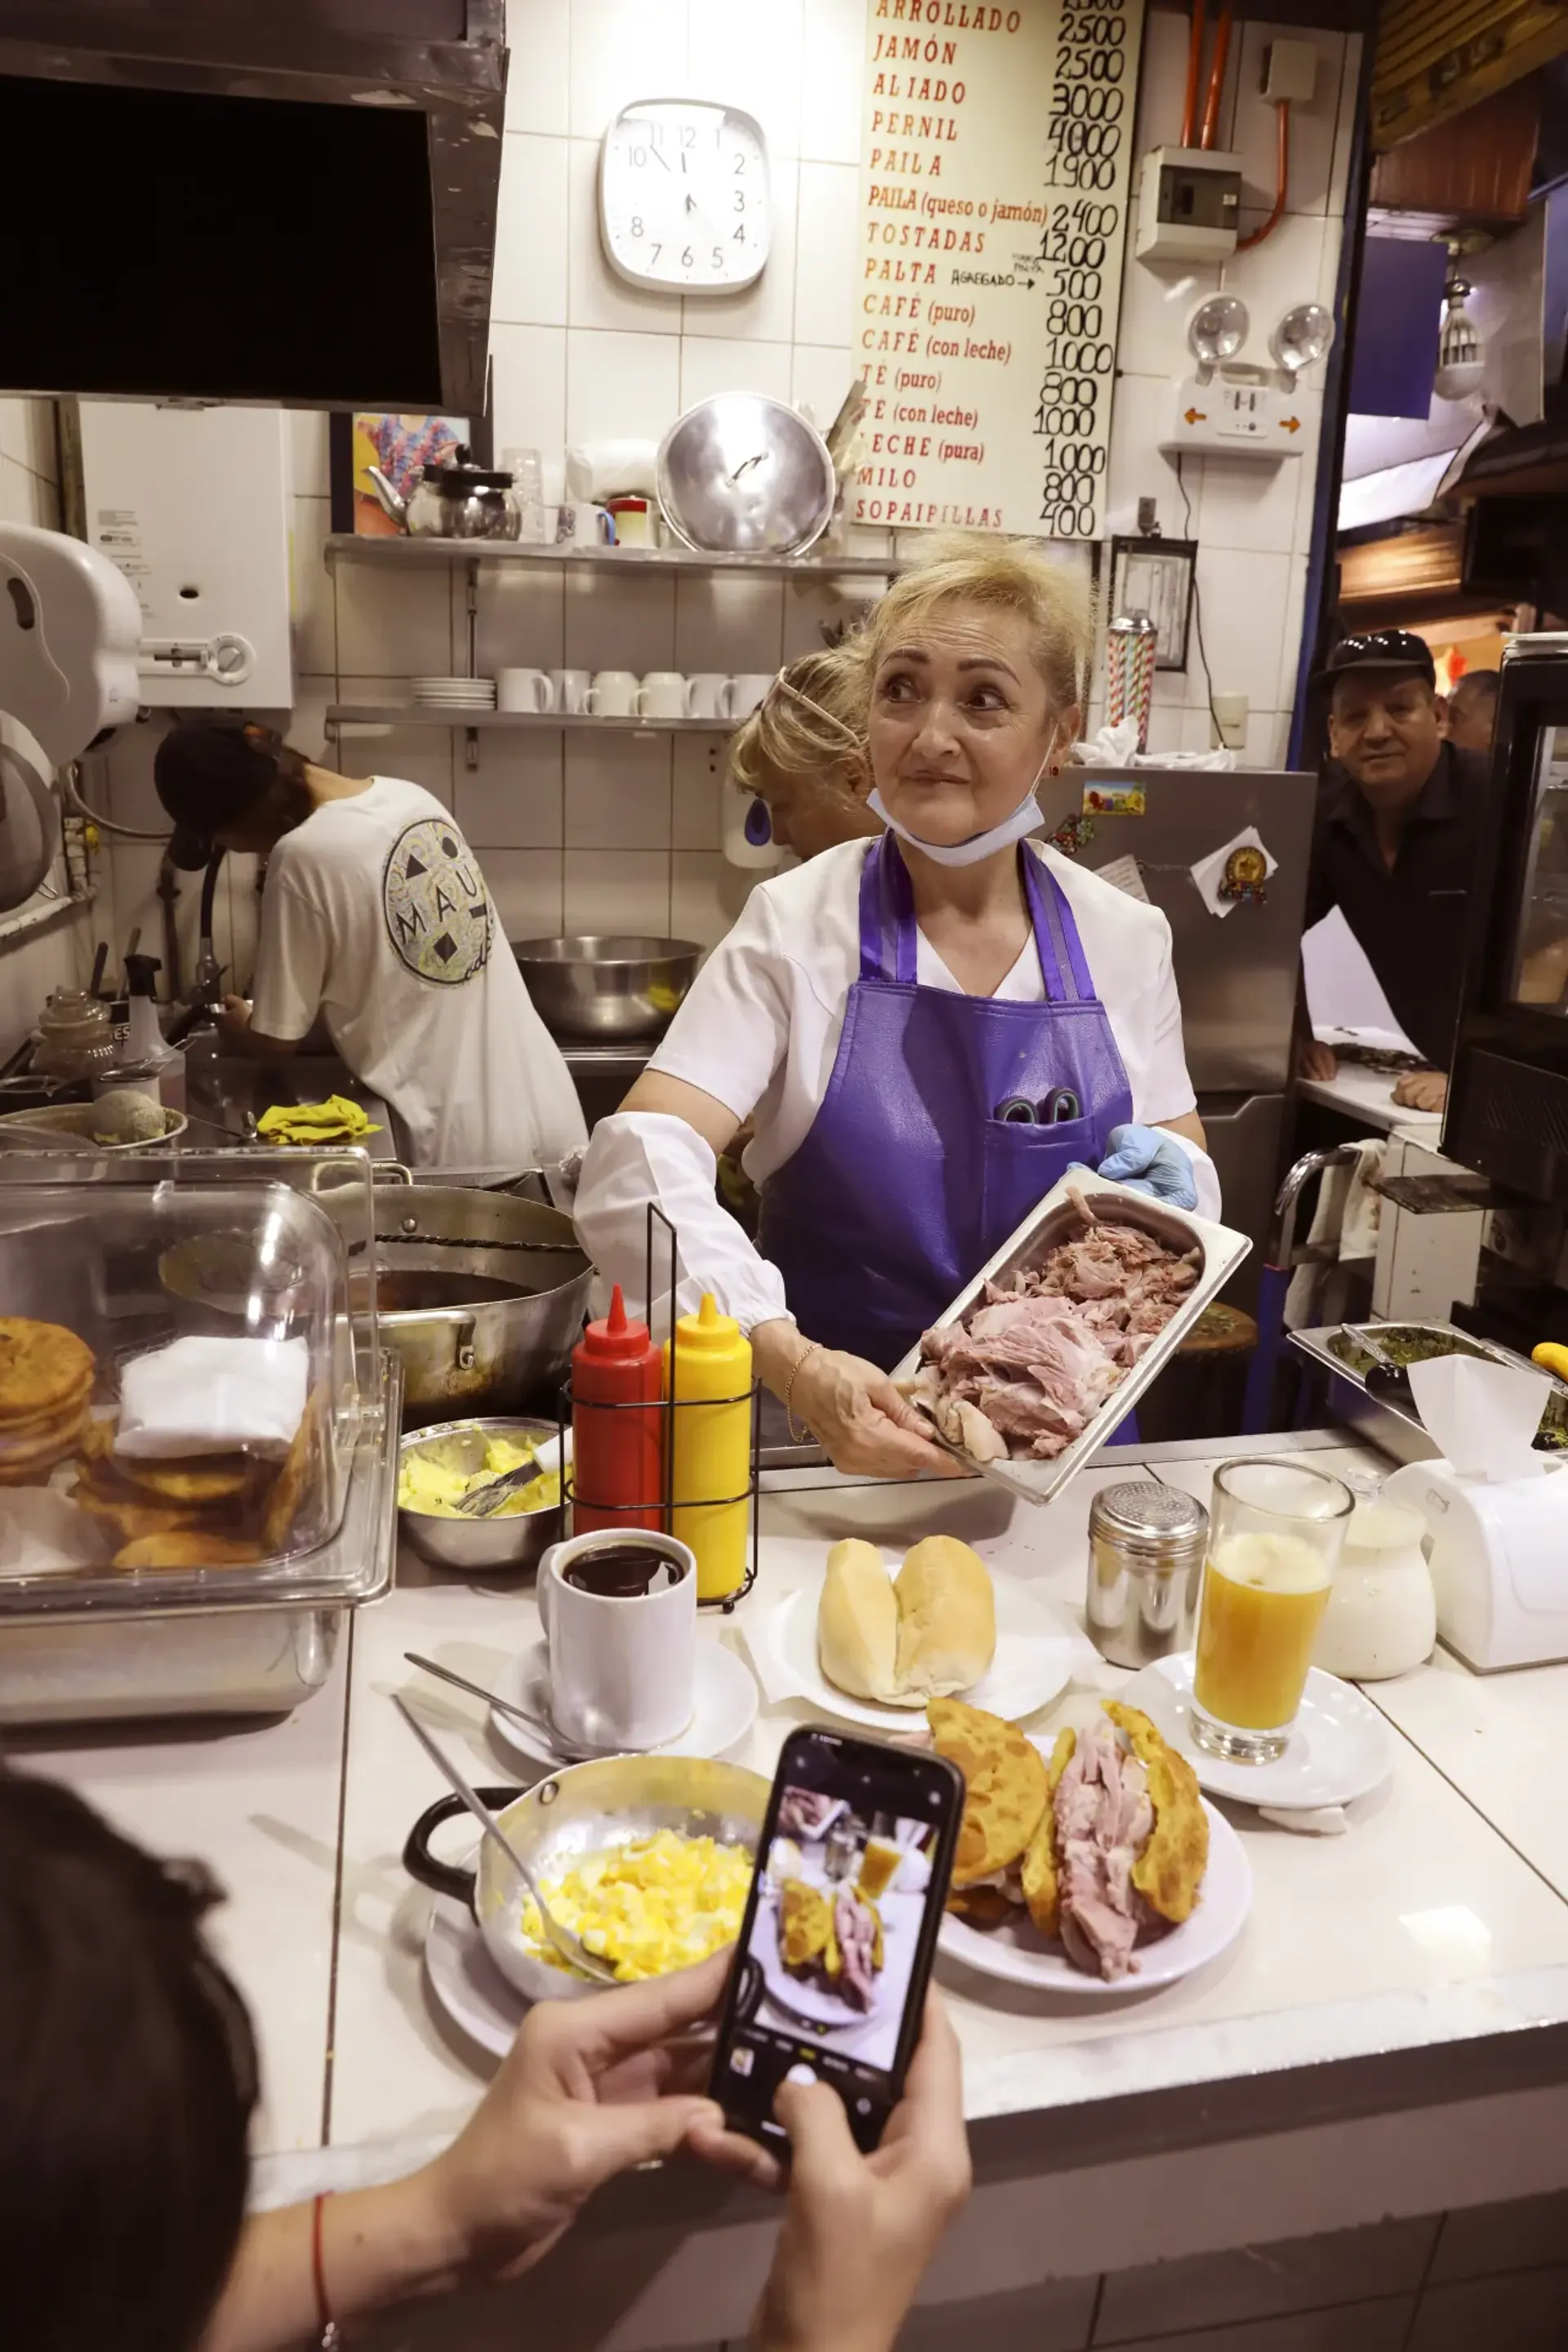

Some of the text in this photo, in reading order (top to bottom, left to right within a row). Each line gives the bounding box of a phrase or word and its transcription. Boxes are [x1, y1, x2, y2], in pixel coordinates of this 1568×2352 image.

[876, 0, 1126, 47] ARROLLADO 2500
[873, 33, 1125, 83] JAMÓN 2500
[873, 73, 1124, 122] ALIADO 3000
[871, 110, 1122, 157] PERNIL 4000
[629, 145, 647, 167] 10
[734, 154, 746, 175] 2
[869, 148, 1116, 190] PAILA 1900
[733, 190, 745, 212] 3
[868, 185, 1119, 237] PAILA (queso o jamón) 2400
[630, 216, 644, 238] 8
[733, 224, 746, 243] 4
[867, 222, 1107, 269] TOSTADAS 1200
[651, 243, 662, 265] 7
[681, 246, 693, 267] 6
[711, 247, 724, 269] 5
[864, 258, 938, 283] PALTA
[1045, 269, 1102, 301] 500
[862, 293, 1102, 339] CAFÉ (puro) 800
[862, 327, 1113, 374] CAFÉ (con leche) 1000
[862, 360, 1098, 408] TÉ (puro) 800
[893, 403, 927, 425] (con
[931, 405, 979, 430] leche)
[1032, 405, 1095, 437] 1000
[860, 433, 1105, 474] ECHE (pura) 1000
[858, 467, 1095, 506] MILO 800
[856, 499, 1095, 536] SOPAIPILLAS 400
